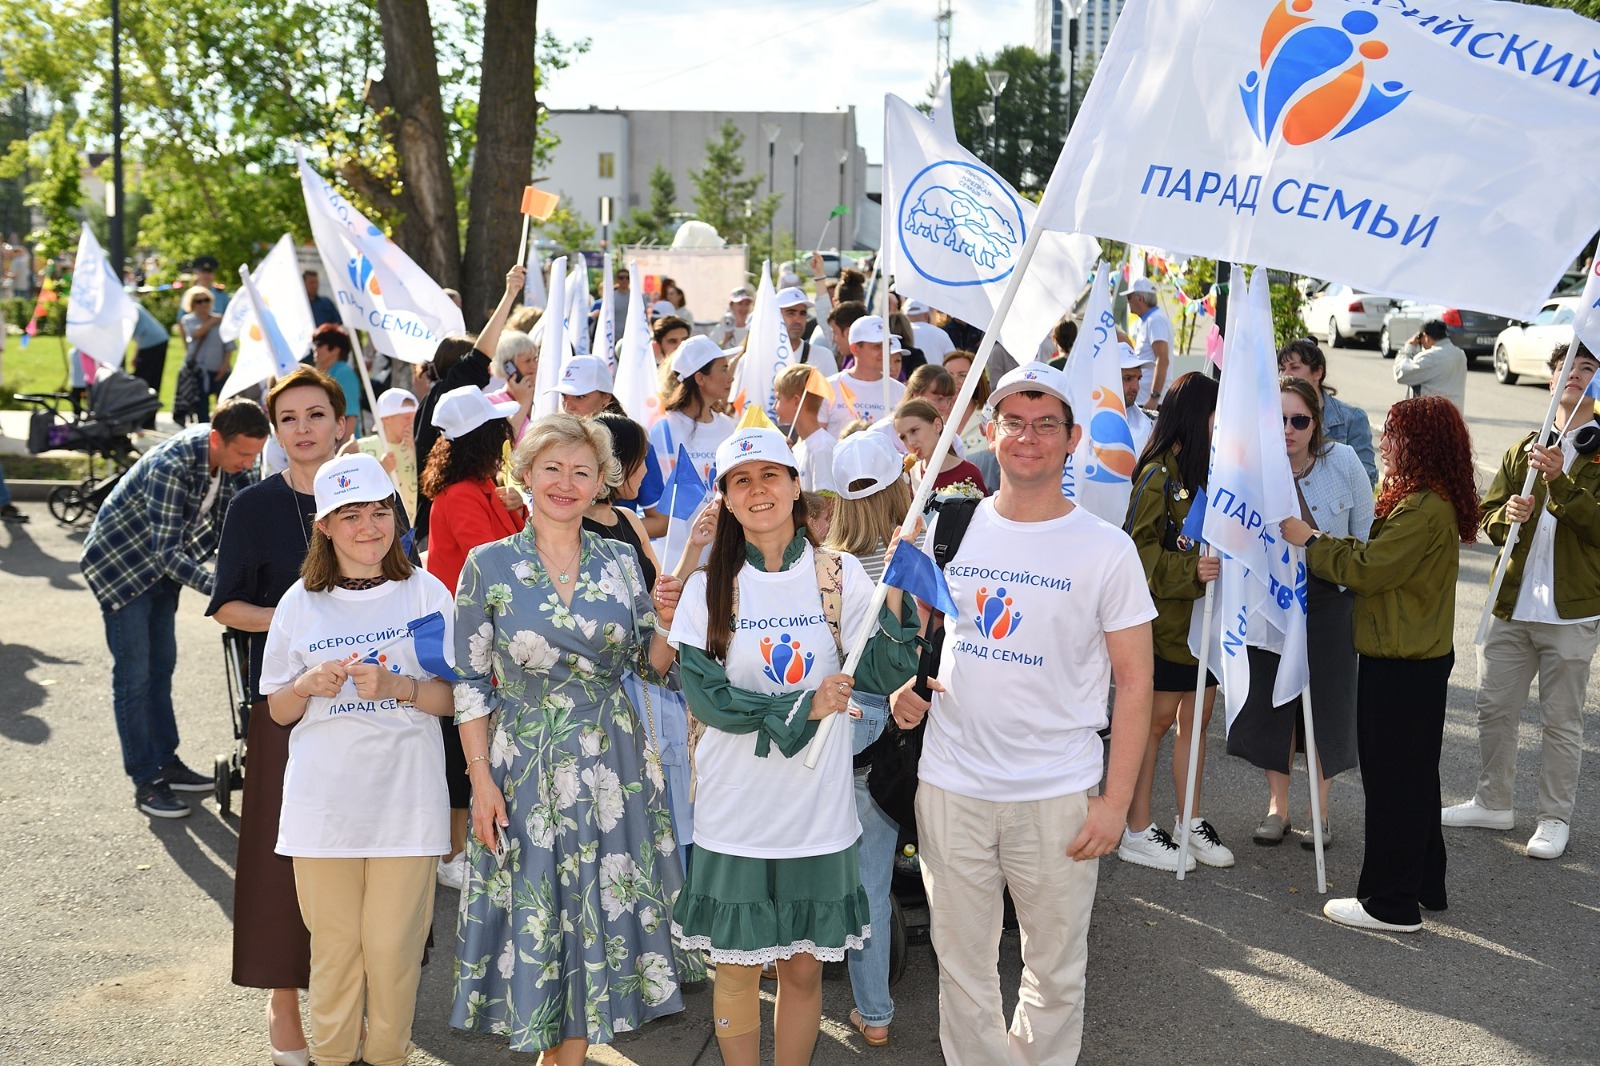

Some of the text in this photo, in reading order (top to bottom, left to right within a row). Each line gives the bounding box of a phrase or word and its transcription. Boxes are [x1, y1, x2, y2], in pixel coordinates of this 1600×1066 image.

[1140, 164, 1440, 248] ПАРАД СЕМЬИ
[950, 566, 1071, 592] ВСЕРОССИЙСКИЙ
[953, 640, 1044, 667] ПАРАД СЕМЬИ
